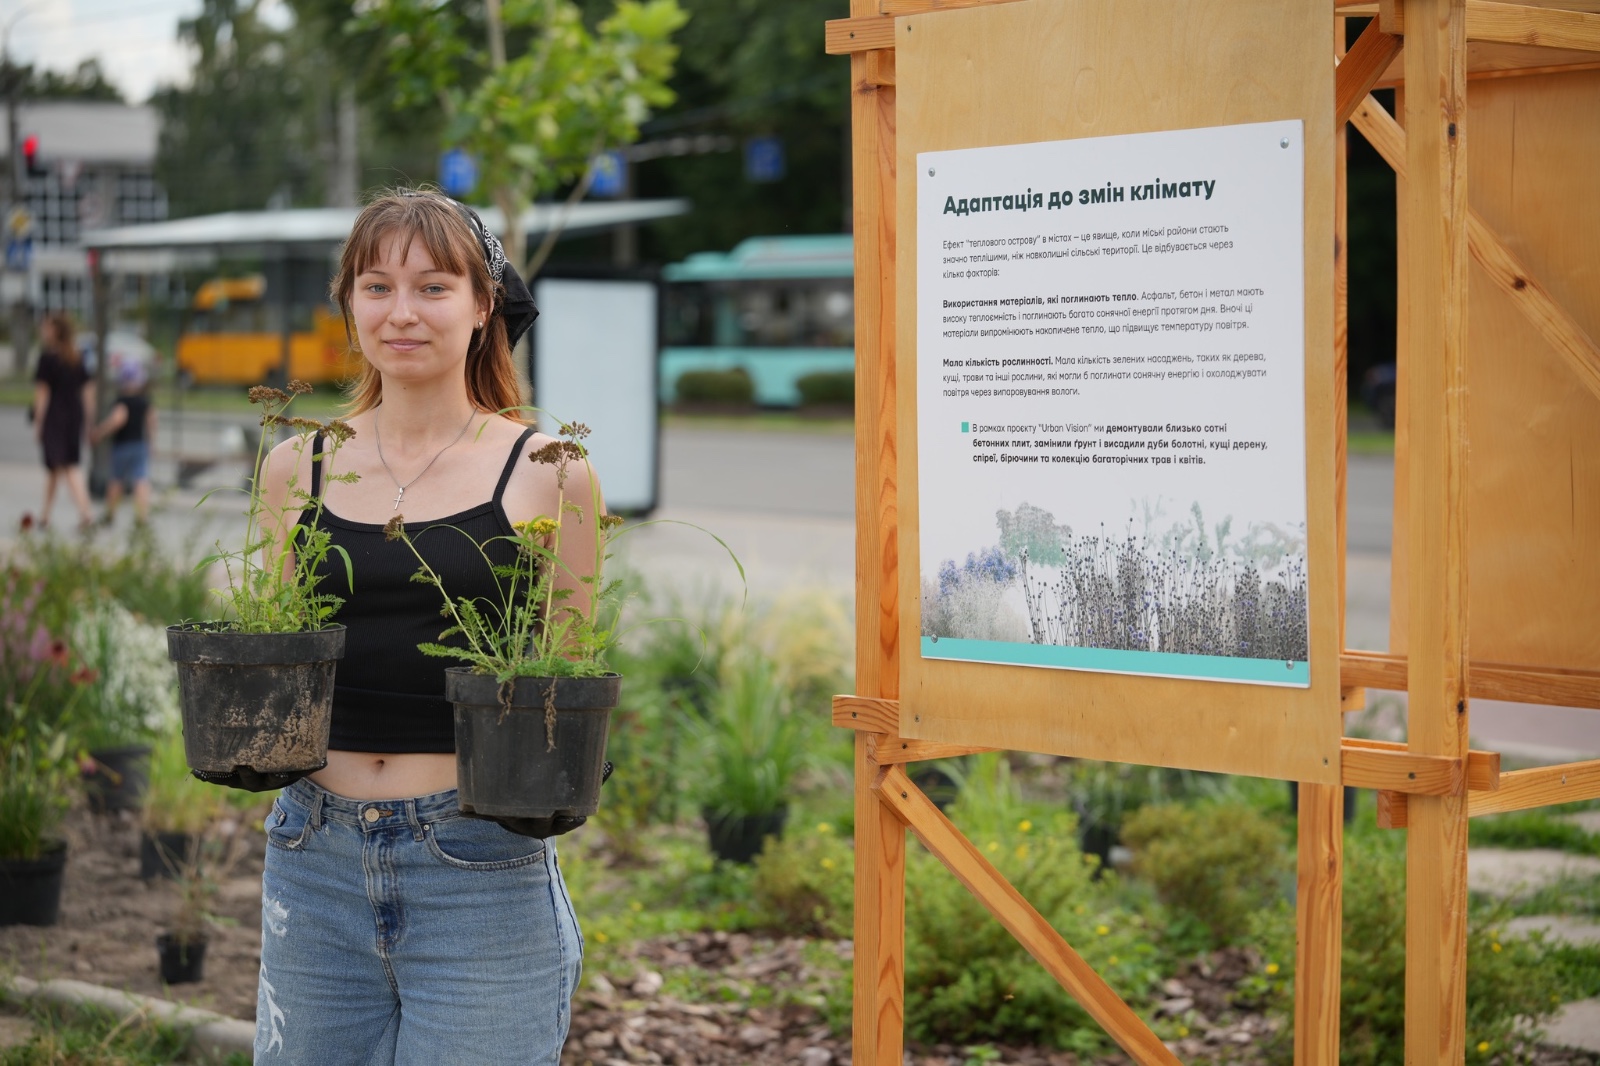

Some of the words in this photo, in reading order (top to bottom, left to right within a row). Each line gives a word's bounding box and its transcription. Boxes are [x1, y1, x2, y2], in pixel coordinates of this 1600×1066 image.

[943, 187, 1043, 217] Адаптація
[1047, 189, 1074, 211] до
[1078, 180, 1124, 205] змін
[1130, 178, 1216, 201] клімату
[942, 240, 965, 251] Ефект
[1048, 233, 1072, 243] містах
[1080, 233, 1091, 243] це
[1092, 231, 1120, 241] явище,
[1121, 230, 1141, 239] коли
[1142, 226, 1165, 238] міські
[1166, 225, 1198, 238] райони
[1198, 225, 1229, 234] стають
[942, 255, 968, 264] значно
[969, 253, 1010, 263] теплішими,
[1011, 251, 1024, 260] ніж
[1025, 248, 1070, 260] навколишні
[1070, 246, 1101, 257] сільські
[1101, 244, 1140, 256] території.
[1141, 243, 1153, 255] Це
[1154, 242, 1207, 254] відбувається
[1208, 240, 1234, 251] через
[942, 269, 965, 279] кілька
[965, 267, 1000, 279] факторів:
[942, 299, 998, 309] Використання
[999, 295, 1045, 307] матеріалів,
[1046, 294, 1059, 305] які
[1060, 294, 1111, 304] поглинають
[1111, 293, 1139, 302] тепло.
[1140, 291, 1177, 302] Асфальт,
[1179, 289, 1204, 299] бетон
[1209, 289, 1235, 298] метал
[1236, 288, 1265, 297] мають
[942, 315, 968, 325] високу
[968, 312, 1017, 322] теплоємність
[1021, 311, 1067, 321] поглинають
[1068, 309, 1095, 319] багато
[1095, 307, 1131, 318] сонячної
[1132, 306, 1160, 318] енергії
[1160, 307, 1199, 317] протягом
[1200, 306, 1218, 316] дня.
[1220, 303, 1243, 314] Вночі
[1244, 302, 1253, 314] ці
[942, 328, 979, 339] матеріали
[980, 327, 1034, 338] випромінюють
[1035, 326, 1080, 335] накопичене
[1081, 325, 1107, 334] тепло,
[1108, 325, 1121, 335] що
[1122, 323, 1159, 334] підвищує
[1160, 322, 1214, 332] температуру
[1215, 320, 1249, 330] повітря.
[942, 358, 964, 368] Мала
[965, 357, 1001, 367] кількість
[1001, 356, 1054, 368] рослинності.
[1054, 356, 1076, 365] Мала
[1077, 355, 1111, 365] кількість
[1112, 356, 1146, 364] зелених
[1147, 355, 1195, 365] насаджень,
[1196, 354, 1220, 362] таких
[1221, 353, 1232, 362] як
[1232, 353, 1266, 363] дерева,
[942, 372, 961, 384] кущі,
[962, 374, 984, 384] трави
[985, 374, 994, 382] та
[995, 371, 1010, 382] інші
[1011, 373, 1046, 383] рослини,
[1046, 371, 1058, 381] які
[1058, 372, 1082, 381] могли
[1090, 371, 1132, 380] поглинати
[1132, 371, 1166, 381] сонячну
[1167, 369, 1200, 380] енергію
[1205, 369, 1267, 379] охолоджувати
[942, 387, 970, 398] повітря
[970, 389, 992, 398] через
[993, 388, 1050, 398] випаровування
[1051, 388, 1080, 396] вологи.
[979, 425, 1006, 434] рамках
[1006, 425, 1037, 435] проєкту
[1093, 425, 1105, 433] ми
[1105, 425, 1164, 435] демонтували
[1165, 423, 1202, 433] близько
[1203, 422, 1227, 433] сотні
[972, 438, 1010, 448] бетонних
[1011, 440, 1033, 449] плит,
[1033, 438, 1072, 448] замінили
[1073, 438, 1097, 450] ґрунт
[1103, 440, 1146, 450] висадили
[1146, 438, 1169, 451] дуби
[1171, 438, 1208, 449] болотні,
[1209, 439, 1231, 451] кущі
[1232, 441, 1268, 451] дерену,
[972, 453, 999, 464] спіреї,
[1000, 453, 1039, 464] бірючини
[1040, 455, 1050, 463] та
[1051, 453, 1090, 465] колекцію
[1091, 454, 1149, 465] багаторічних
[1150, 456, 1172, 466] трав
[1178, 454, 1206, 465] квітів.
